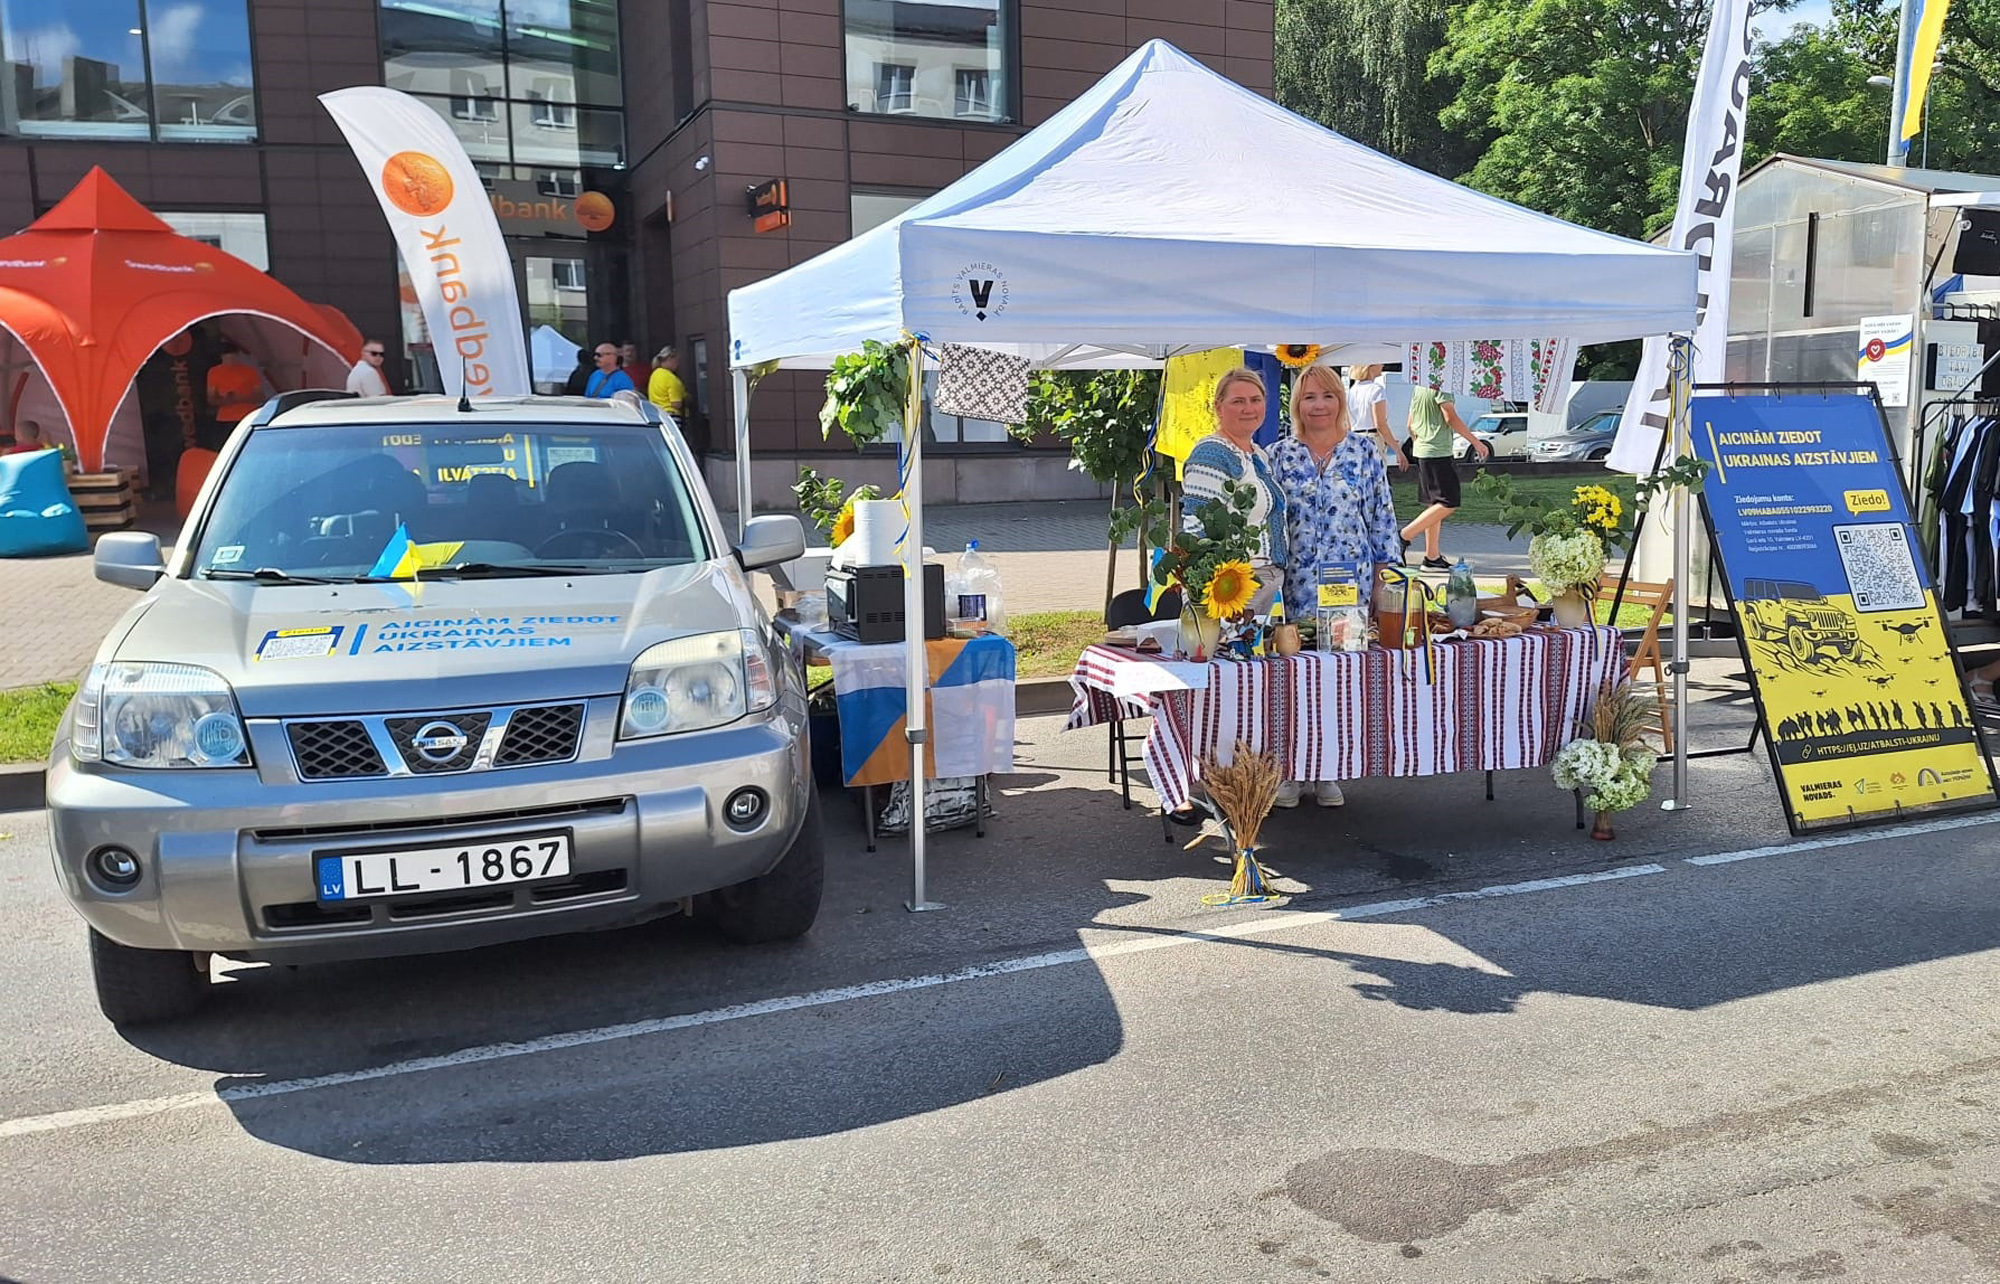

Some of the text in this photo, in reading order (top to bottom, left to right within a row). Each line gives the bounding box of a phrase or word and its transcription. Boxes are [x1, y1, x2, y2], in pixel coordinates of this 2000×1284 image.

[956, 262, 1003, 280] VALMIERAS
[1719, 429, 1821, 445] AICINĀM ZIEDOT
[1723, 450, 1878, 467] UKRAINAS AIZSTĀVJIEM
[1850, 495, 1886, 505] Ziedo!
[521, 616, 619, 624] ZIEDOT
[379, 627, 535, 640] UKRAINAS
[374, 637, 570, 653] AIZSTĀVJIEM
[418, 737, 464, 748] NISSAN
[1800, 780, 1843, 793] VALMIERAS
[323, 884, 341, 895] LV
